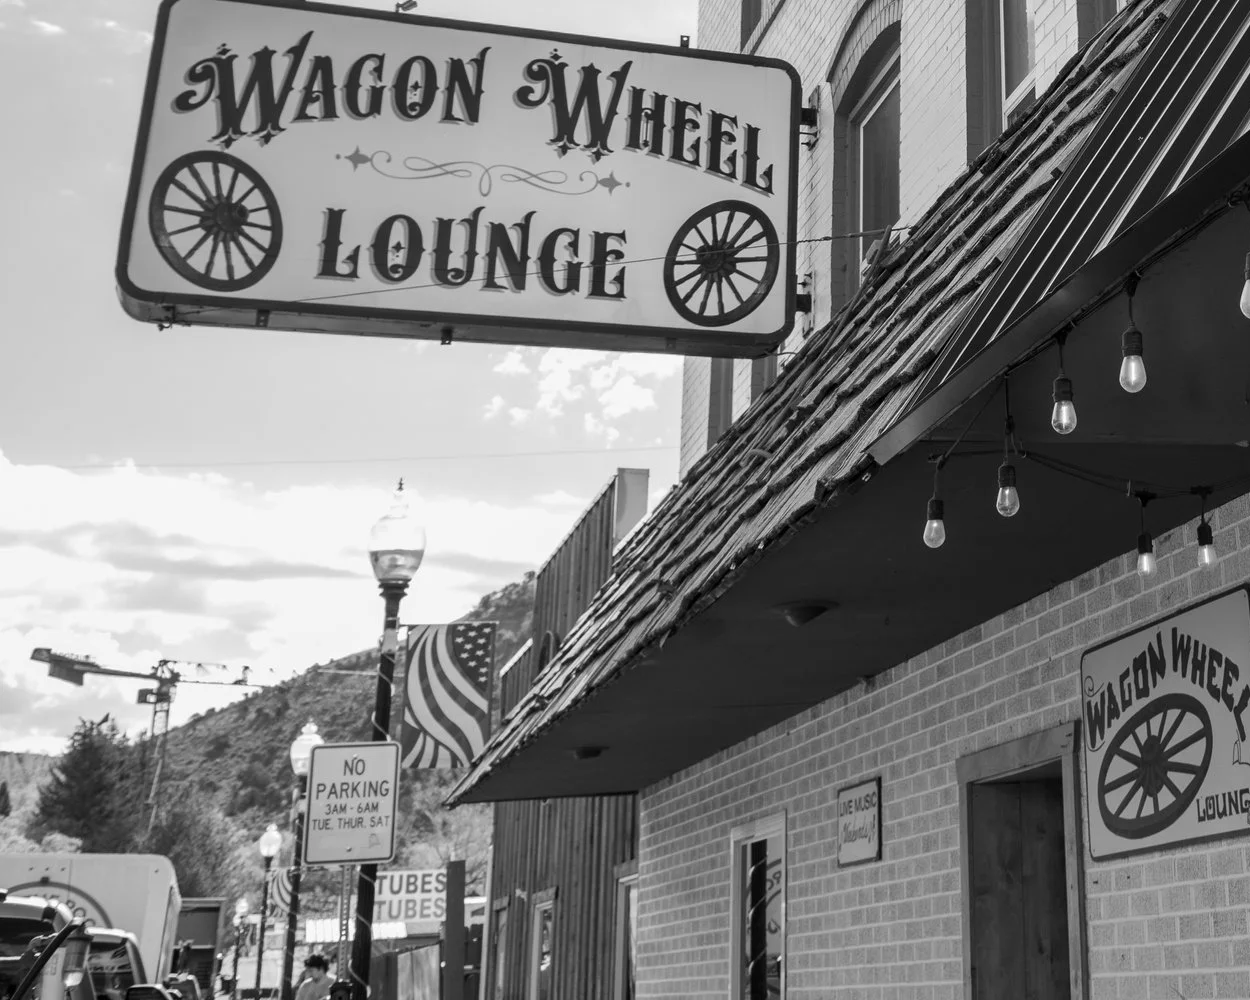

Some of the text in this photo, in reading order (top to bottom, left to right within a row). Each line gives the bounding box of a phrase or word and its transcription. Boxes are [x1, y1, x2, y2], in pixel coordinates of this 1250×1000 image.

[172, 30, 775, 194] WAGON WHEEL
[315, 205, 628, 300] LOUNGE
[1086, 627, 1250, 749] WAGON WHEEL
[343, 759, 366, 776] NO
[316, 780, 390, 800] PARKING
[325, 804, 347, 815] 3AM
[357, 802, 379, 813] 6AM
[369, 815, 390, 827] SAT
[376, 872, 446, 896] TUBES
[375, 897, 446, 920] TUBES
